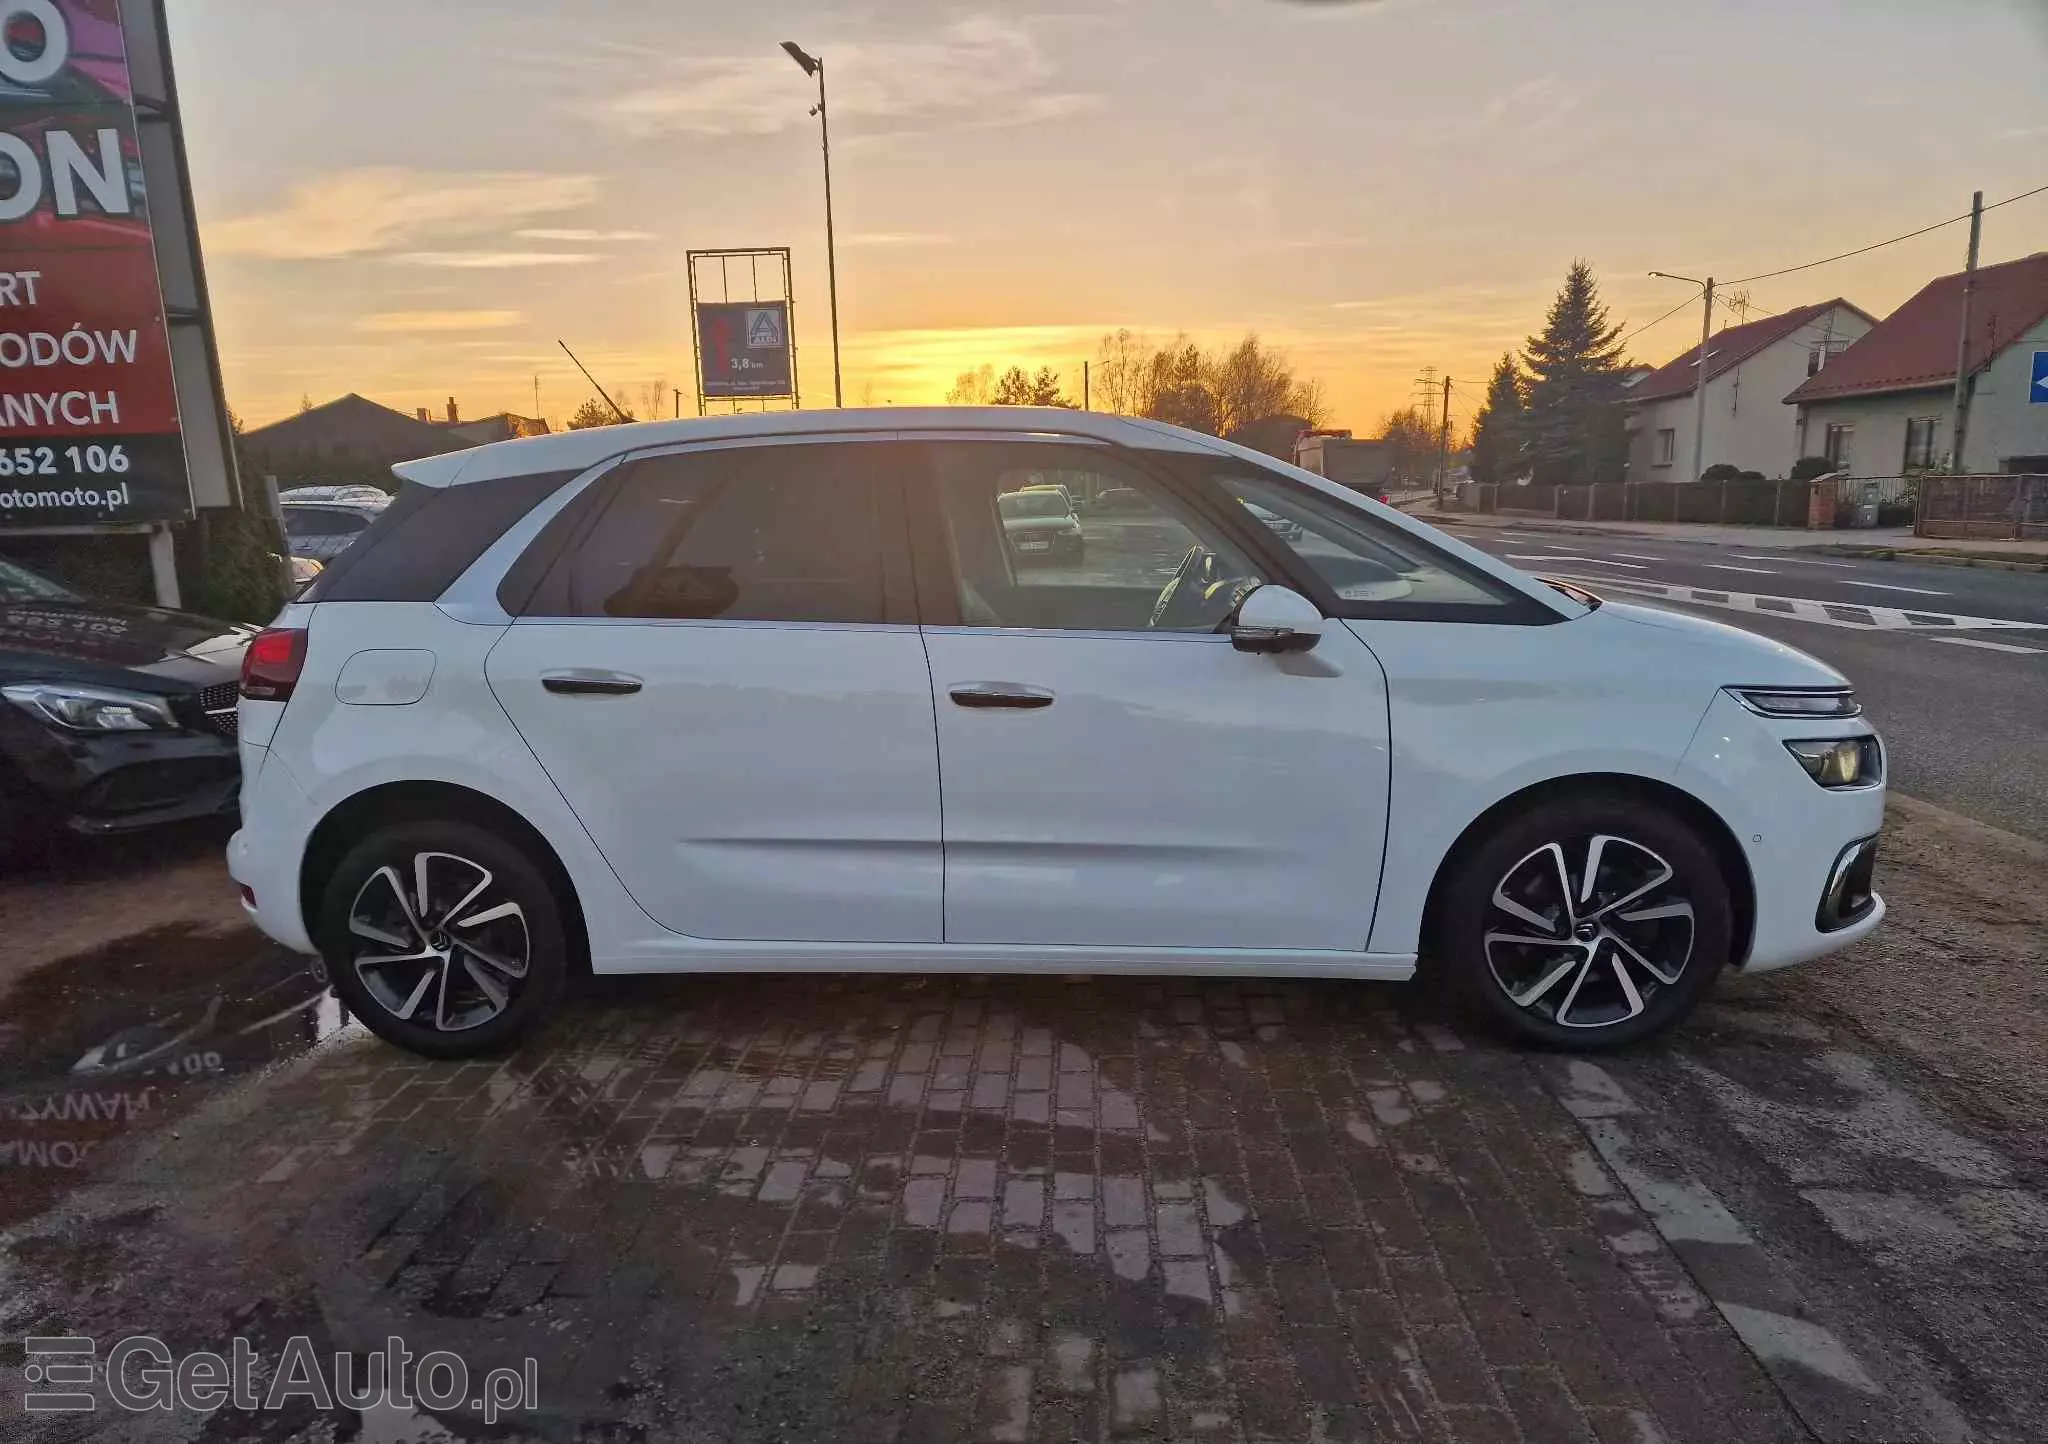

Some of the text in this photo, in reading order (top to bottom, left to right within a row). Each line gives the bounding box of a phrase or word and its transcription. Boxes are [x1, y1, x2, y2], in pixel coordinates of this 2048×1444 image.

[0, 270, 42, 306] RT
[0, 322, 137, 368] ODÓW
[64, 445, 129, 473] 106
[0, 482, 129, 512] otomoto.pl
